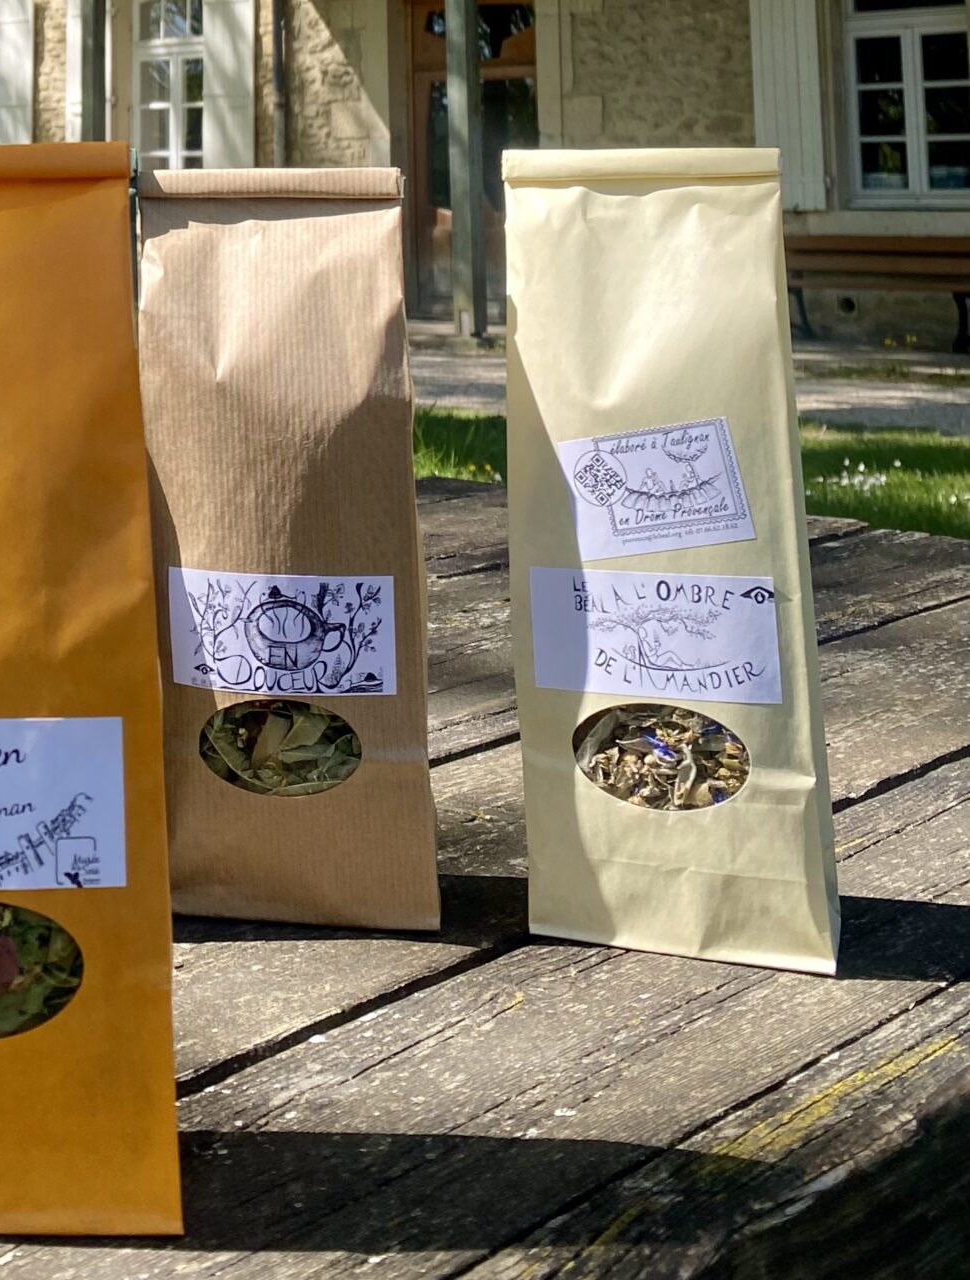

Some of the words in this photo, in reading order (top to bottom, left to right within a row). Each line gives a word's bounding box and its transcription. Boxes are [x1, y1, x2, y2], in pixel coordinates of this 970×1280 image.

[609, 440, 647, 455] élaboré
[662, 431, 711, 450] Taulignan
[673, 497, 730, 519] Provençale
[573, 576, 588, 592] LE
[267, 644, 299, 669] EN
[593, 647, 617, 675] DE
[214, 654, 332, 693] DOUCEUR
